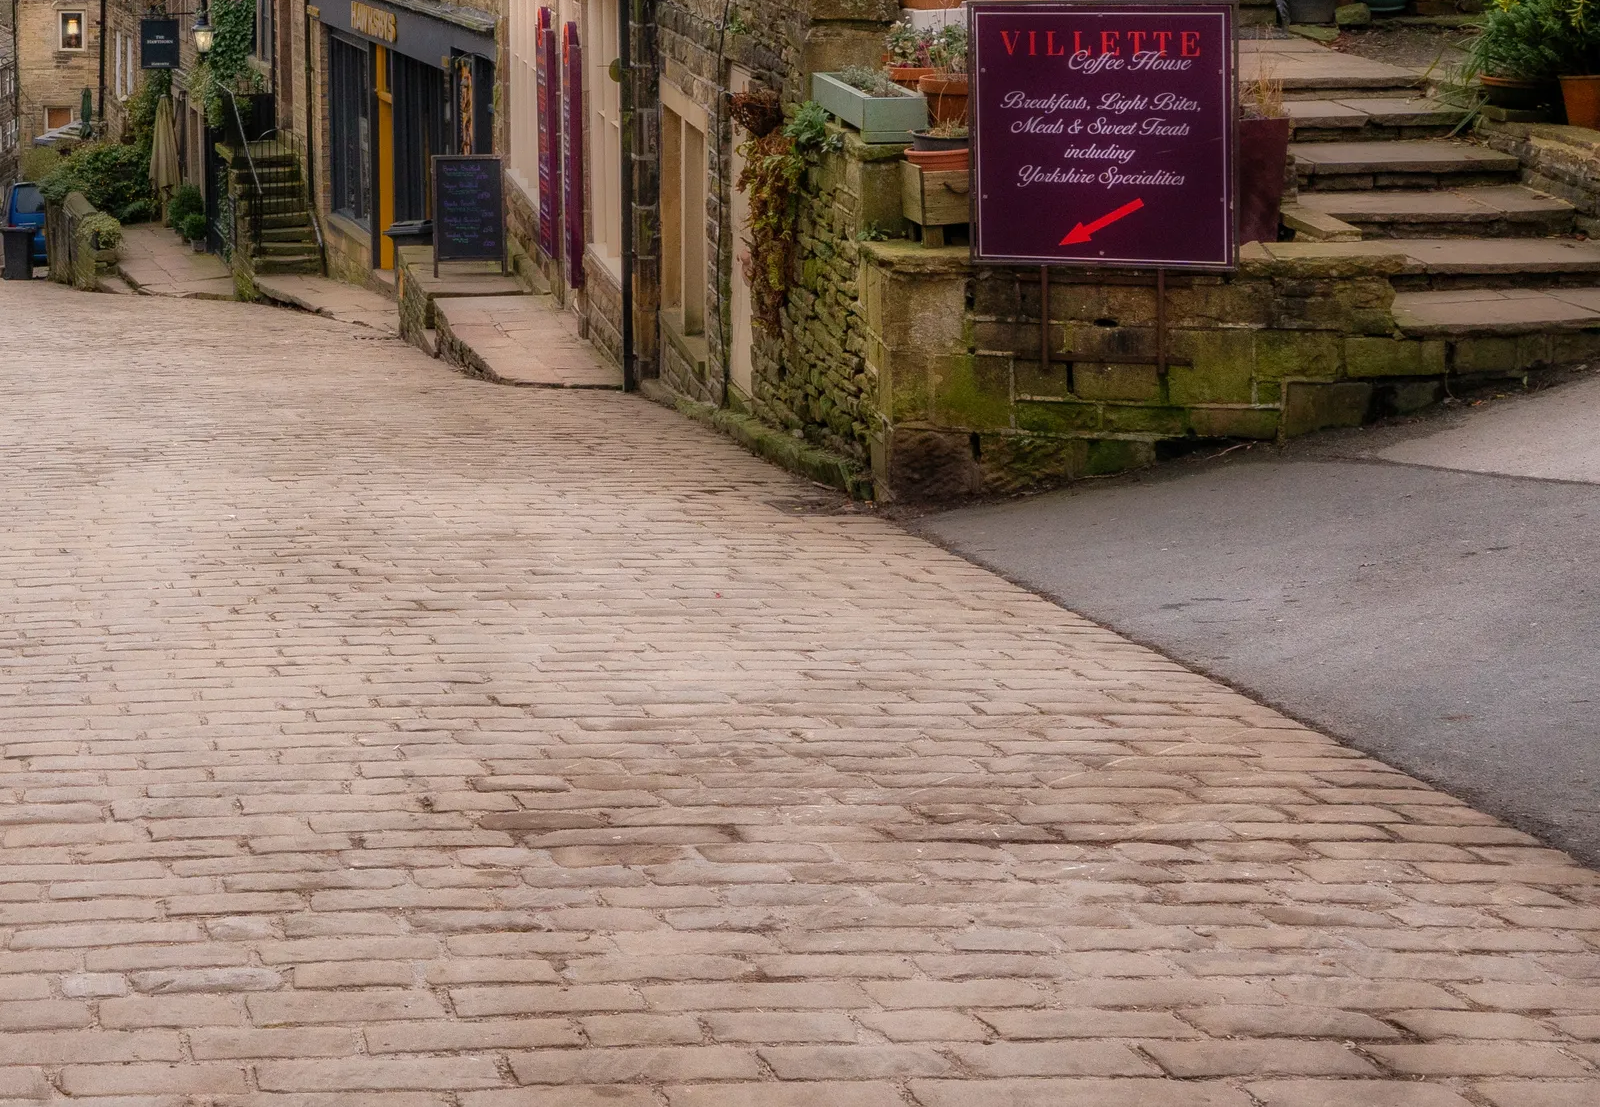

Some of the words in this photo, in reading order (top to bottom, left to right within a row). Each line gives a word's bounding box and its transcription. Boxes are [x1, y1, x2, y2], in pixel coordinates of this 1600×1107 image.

[999, 30, 1202, 58] VILLETTE
[1068, 50, 1125, 75] Coffee
[1127, 50, 1192, 72] House
[1000, 90, 1091, 113] Breakfasts,
[1096, 92, 1147, 113] Light
[1149, 92, 1202, 113] Bites,
[1010, 116, 1064, 136] Meals
[1068, 120, 1083, 135] &
[1086, 117, 1136, 136] Sweet
[1138, 117, 1191, 137] Treats
[1064, 143, 1136, 164] including
[1016, 165, 1095, 187] Yorkshire
[1098, 166, 1186, 189] Specialities
